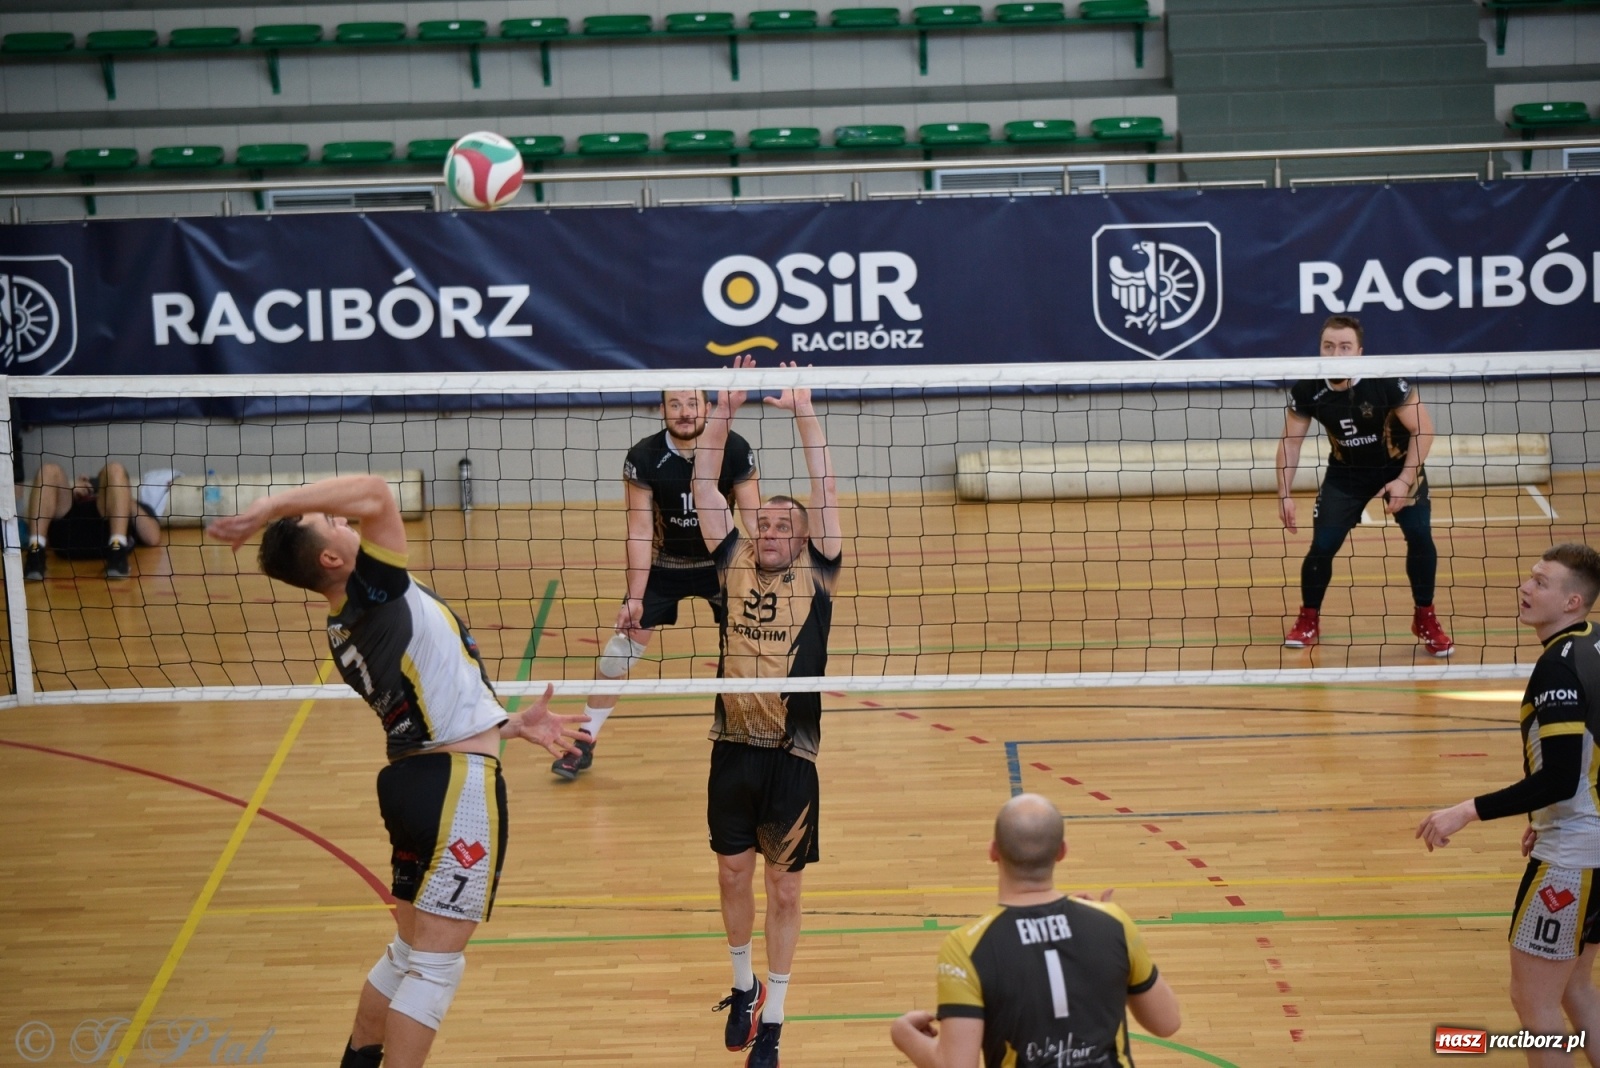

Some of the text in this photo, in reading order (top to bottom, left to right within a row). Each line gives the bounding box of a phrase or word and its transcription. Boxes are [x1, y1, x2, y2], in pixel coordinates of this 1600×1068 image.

[152, 267, 534, 346] RACIBÓRZ
[791, 324, 924, 352] RACIBÓRZ
[1340, 418, 1358, 436] 5
[670, 516, 700, 528] AGRO
[743, 588, 777, 623] 23
[340, 645, 374, 696] 7
[449, 873, 469, 903] 7
[1015, 914, 1073, 945] ENTER
[1533, 915, 1561, 944] 10
[1044, 948, 1070, 1019] 1
